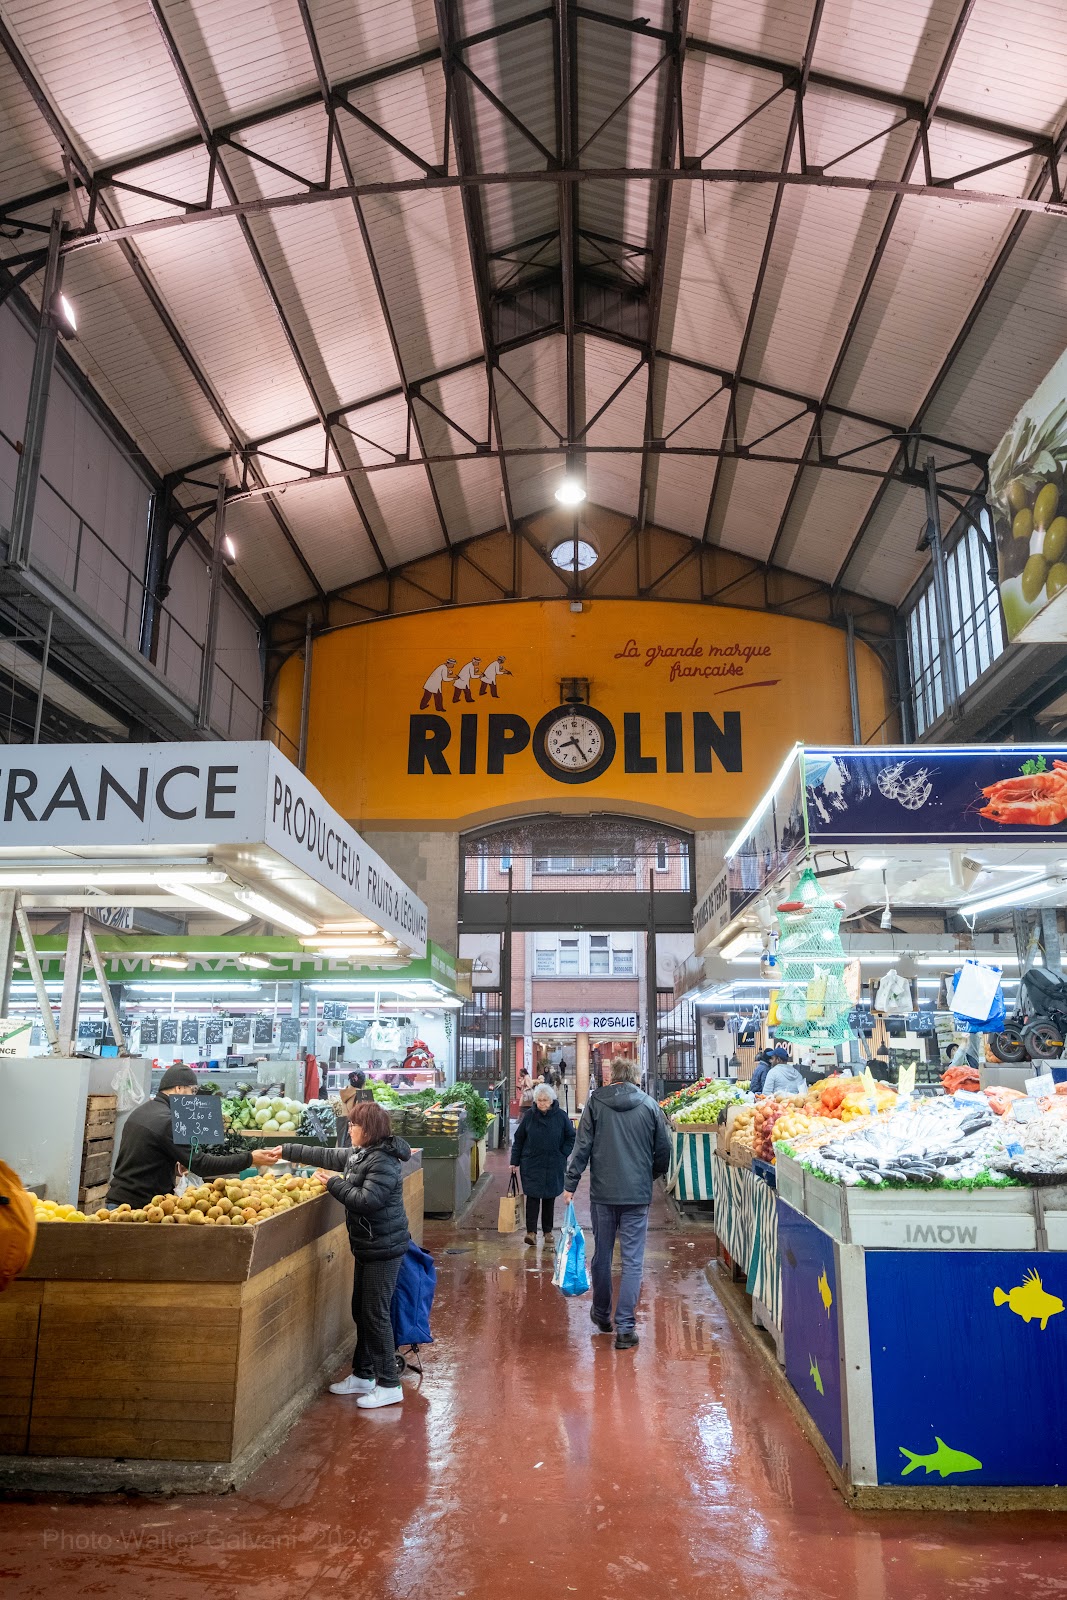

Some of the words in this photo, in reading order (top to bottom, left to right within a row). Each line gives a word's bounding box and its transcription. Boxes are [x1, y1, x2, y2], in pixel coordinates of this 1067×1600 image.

[614, 639, 641, 658] La
[645, 638, 703, 667] grande
[708, 643, 771, 663] marque
[670, 661, 744, 682] française
[407, 703, 743, 784] RIPOLIN
[0, 764, 238, 823] RANCE
[272, 775, 361, 892] PRODUCTEUR
[367, 865, 393, 917] FRUITS
[394, 891, 399, 923] &
[400, 892, 427, 945] LÉGUMES
[534, 1017, 575, 1028] GALERIE
[905, 1224, 978, 1244] MOWI
